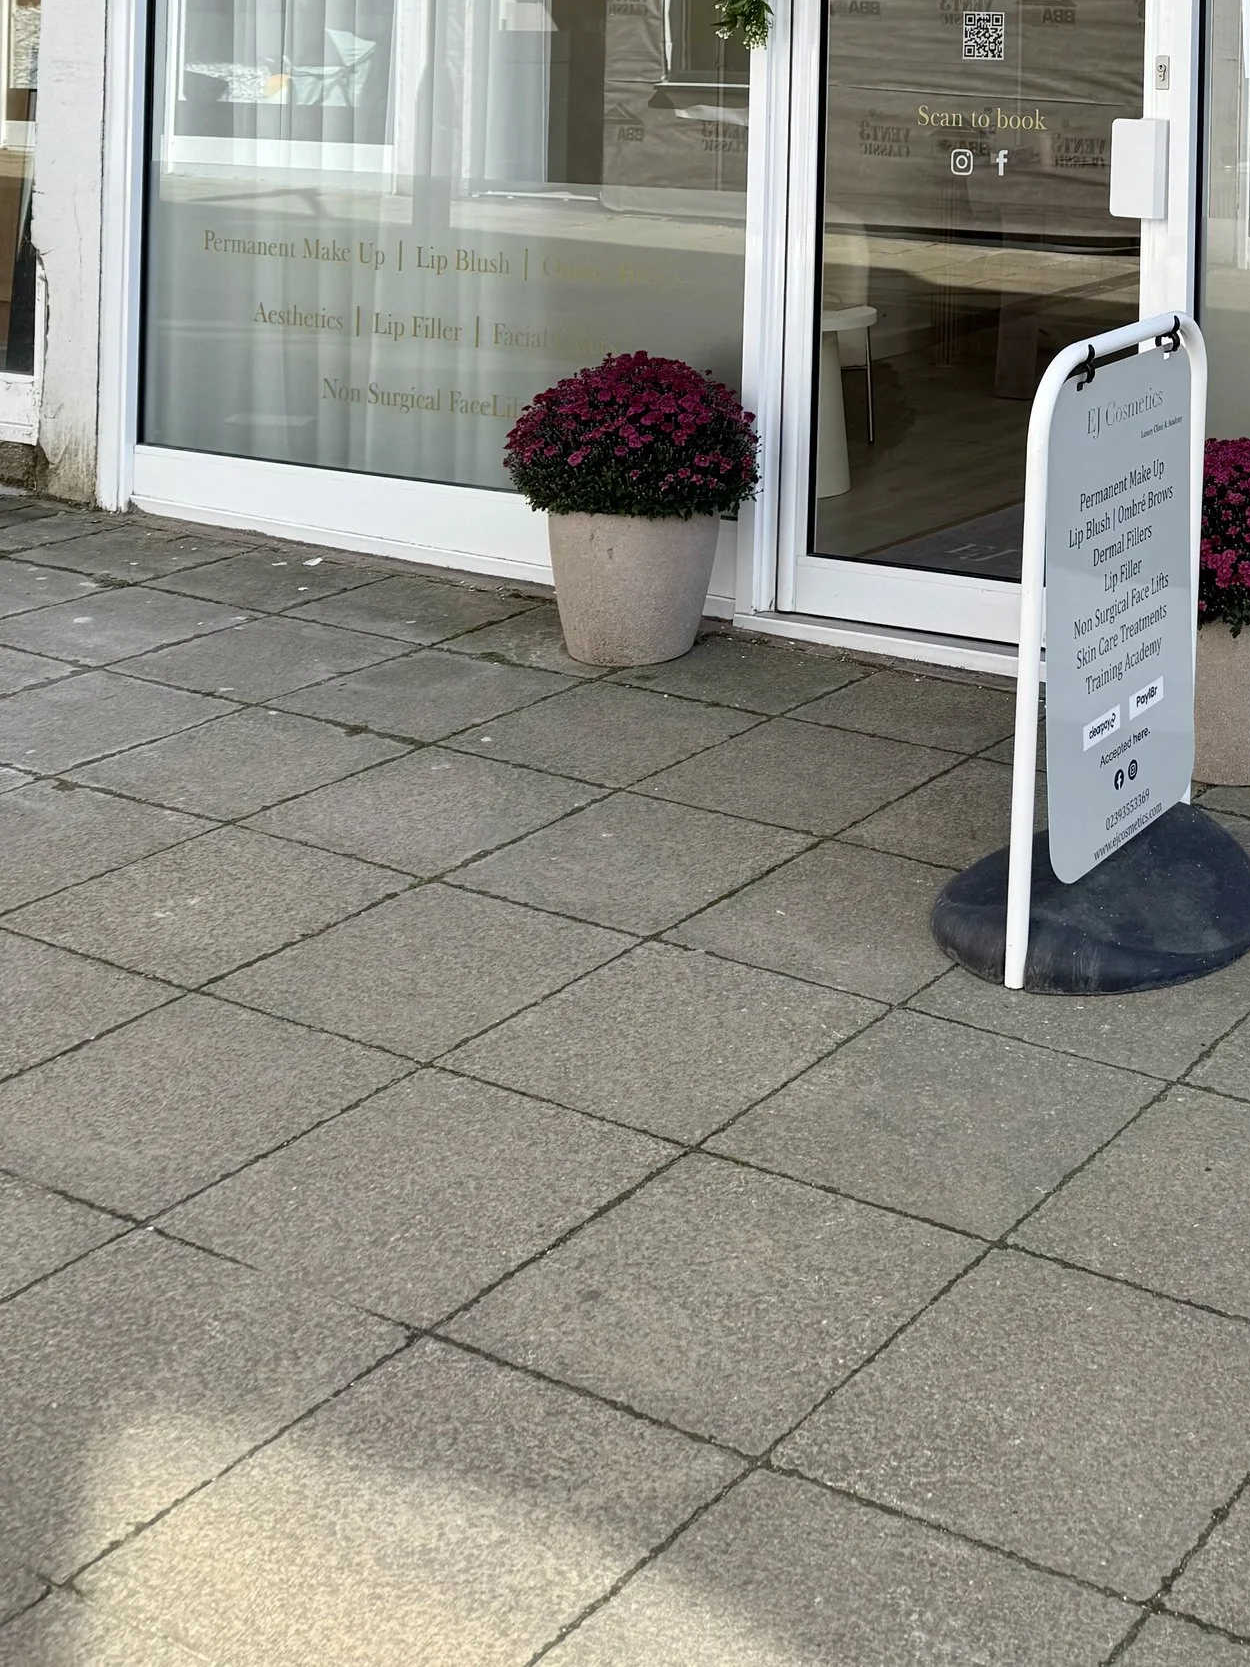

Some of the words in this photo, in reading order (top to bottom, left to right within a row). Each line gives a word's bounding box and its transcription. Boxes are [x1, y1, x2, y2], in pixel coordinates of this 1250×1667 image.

[917, 104, 963, 129] Scan
[971, 109, 990, 129] to
[996, 106, 1048, 131] book
[203, 229, 296, 260] Permanent
[302, 237, 352, 263] Make
[358, 242, 386, 268] Up
[416, 245, 449, 275] Lip
[455, 248, 510, 276] Blush
[254, 302, 344, 331] Aesthetics
[372, 311, 405, 342] Lip
[411, 315, 463, 342] Filler
[492, 321, 548, 349] Facial
[321, 376, 361, 403] Non
[367, 381, 441, 415] Surgical
[1087, 406, 1102, 440] EJ
[1105, 387, 1163, 426] Cosmetics
[1080, 475, 1128, 512] Permanent
[1129, 467, 1152, 491] Make
[1152, 458, 1165, 481] Up
[1069, 526, 1084, 550] Lip
[1086, 514, 1111, 541] Blush
[1117, 492, 1147, 525] Ombré
[1148, 484, 1174, 511] Brows
[1093, 540, 1125, 567] Dermal
[1126, 524, 1153, 551] Fillers
[1104, 570, 1119, 592] Lip
[1119, 558, 1143, 583] Filler
[1073, 616, 1093, 640] Non
[1094, 593, 1130, 631] Surgical
[1130, 590, 1150, 613] Face
[1151, 571, 1169, 596] Lifts
[1076, 643, 1097, 670] Skin
[1098, 635, 1119, 657] Care
[1119, 603, 1168, 644] Treatments
[1085, 663, 1124, 695] Training
[1124, 636, 1163, 676] Academy
[1099, 737, 1132, 768] Accepted
[1093, 800, 1163, 862] www.ejcosmetics.com
[1105, 787, 1151, 831] 02393553369
